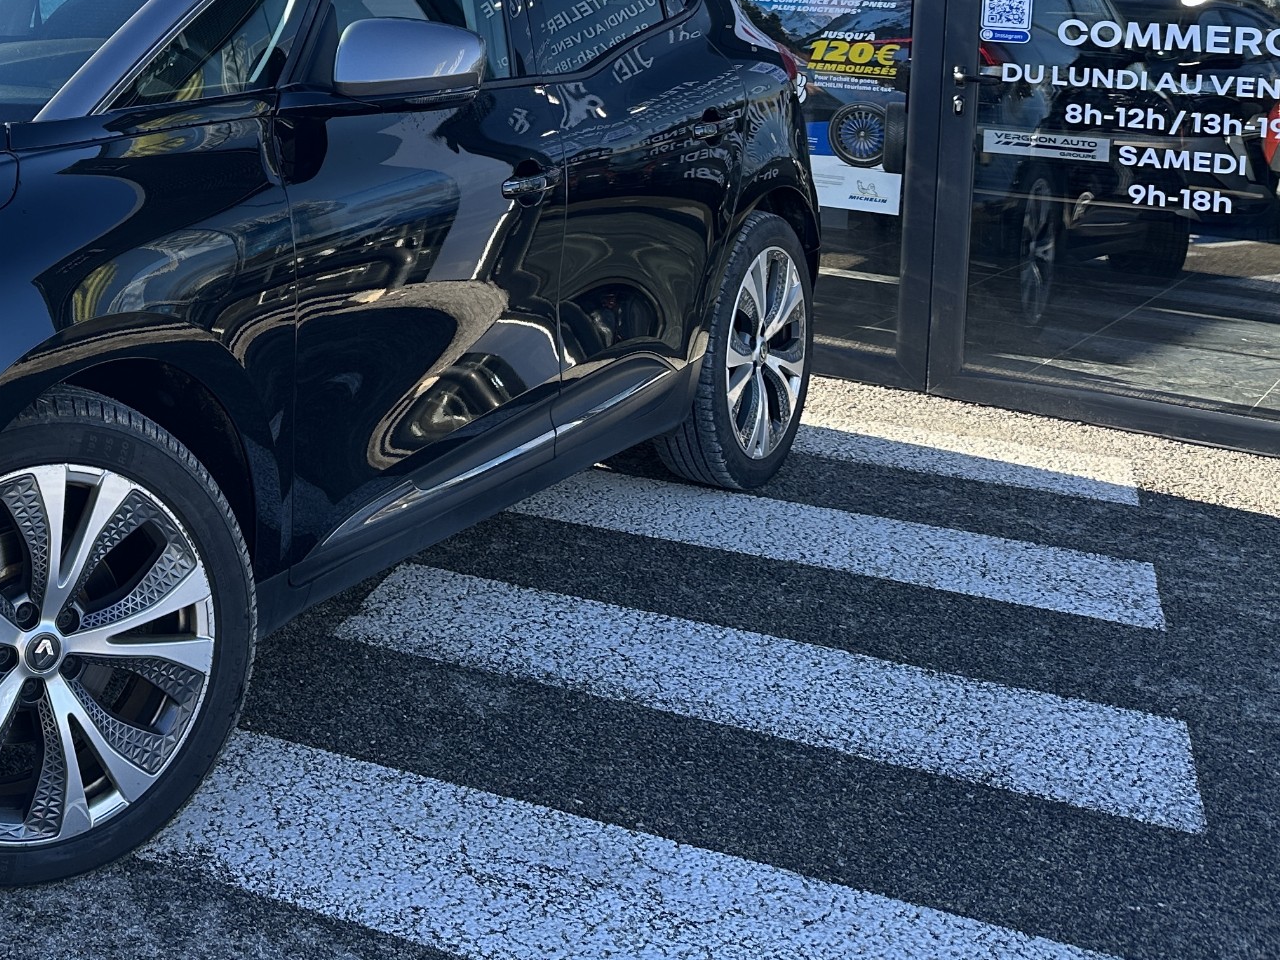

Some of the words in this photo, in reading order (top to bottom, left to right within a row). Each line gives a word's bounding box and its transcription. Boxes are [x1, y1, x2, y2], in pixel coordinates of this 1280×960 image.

[771, 4, 796, 12] PLUS
[841, 0, 860, 7] VOS
[861, 0, 897, 9] PNEUS
[994, 31, 1024, 40] Instagram
[810, 40, 901, 66] 120€
[807, 61, 897, 76] REMBOURSÉS
[1001, 62, 1044, 84] DU
[1051, 65, 1147, 92] LUNDI
[1154, 72, 1203, 95] AU
[814, 80, 843, 88] MICHELIN
[844, 83, 872, 91] tourisme
[1060, 138, 1097, 148] AUTO
[1059, 151, 1097, 160] GROUPE
[1118, 146, 1247, 176] SAMEDI
[848, 195, 888, 204] MICHELIN
[1128, 184, 1232, 214] 9h-18h
